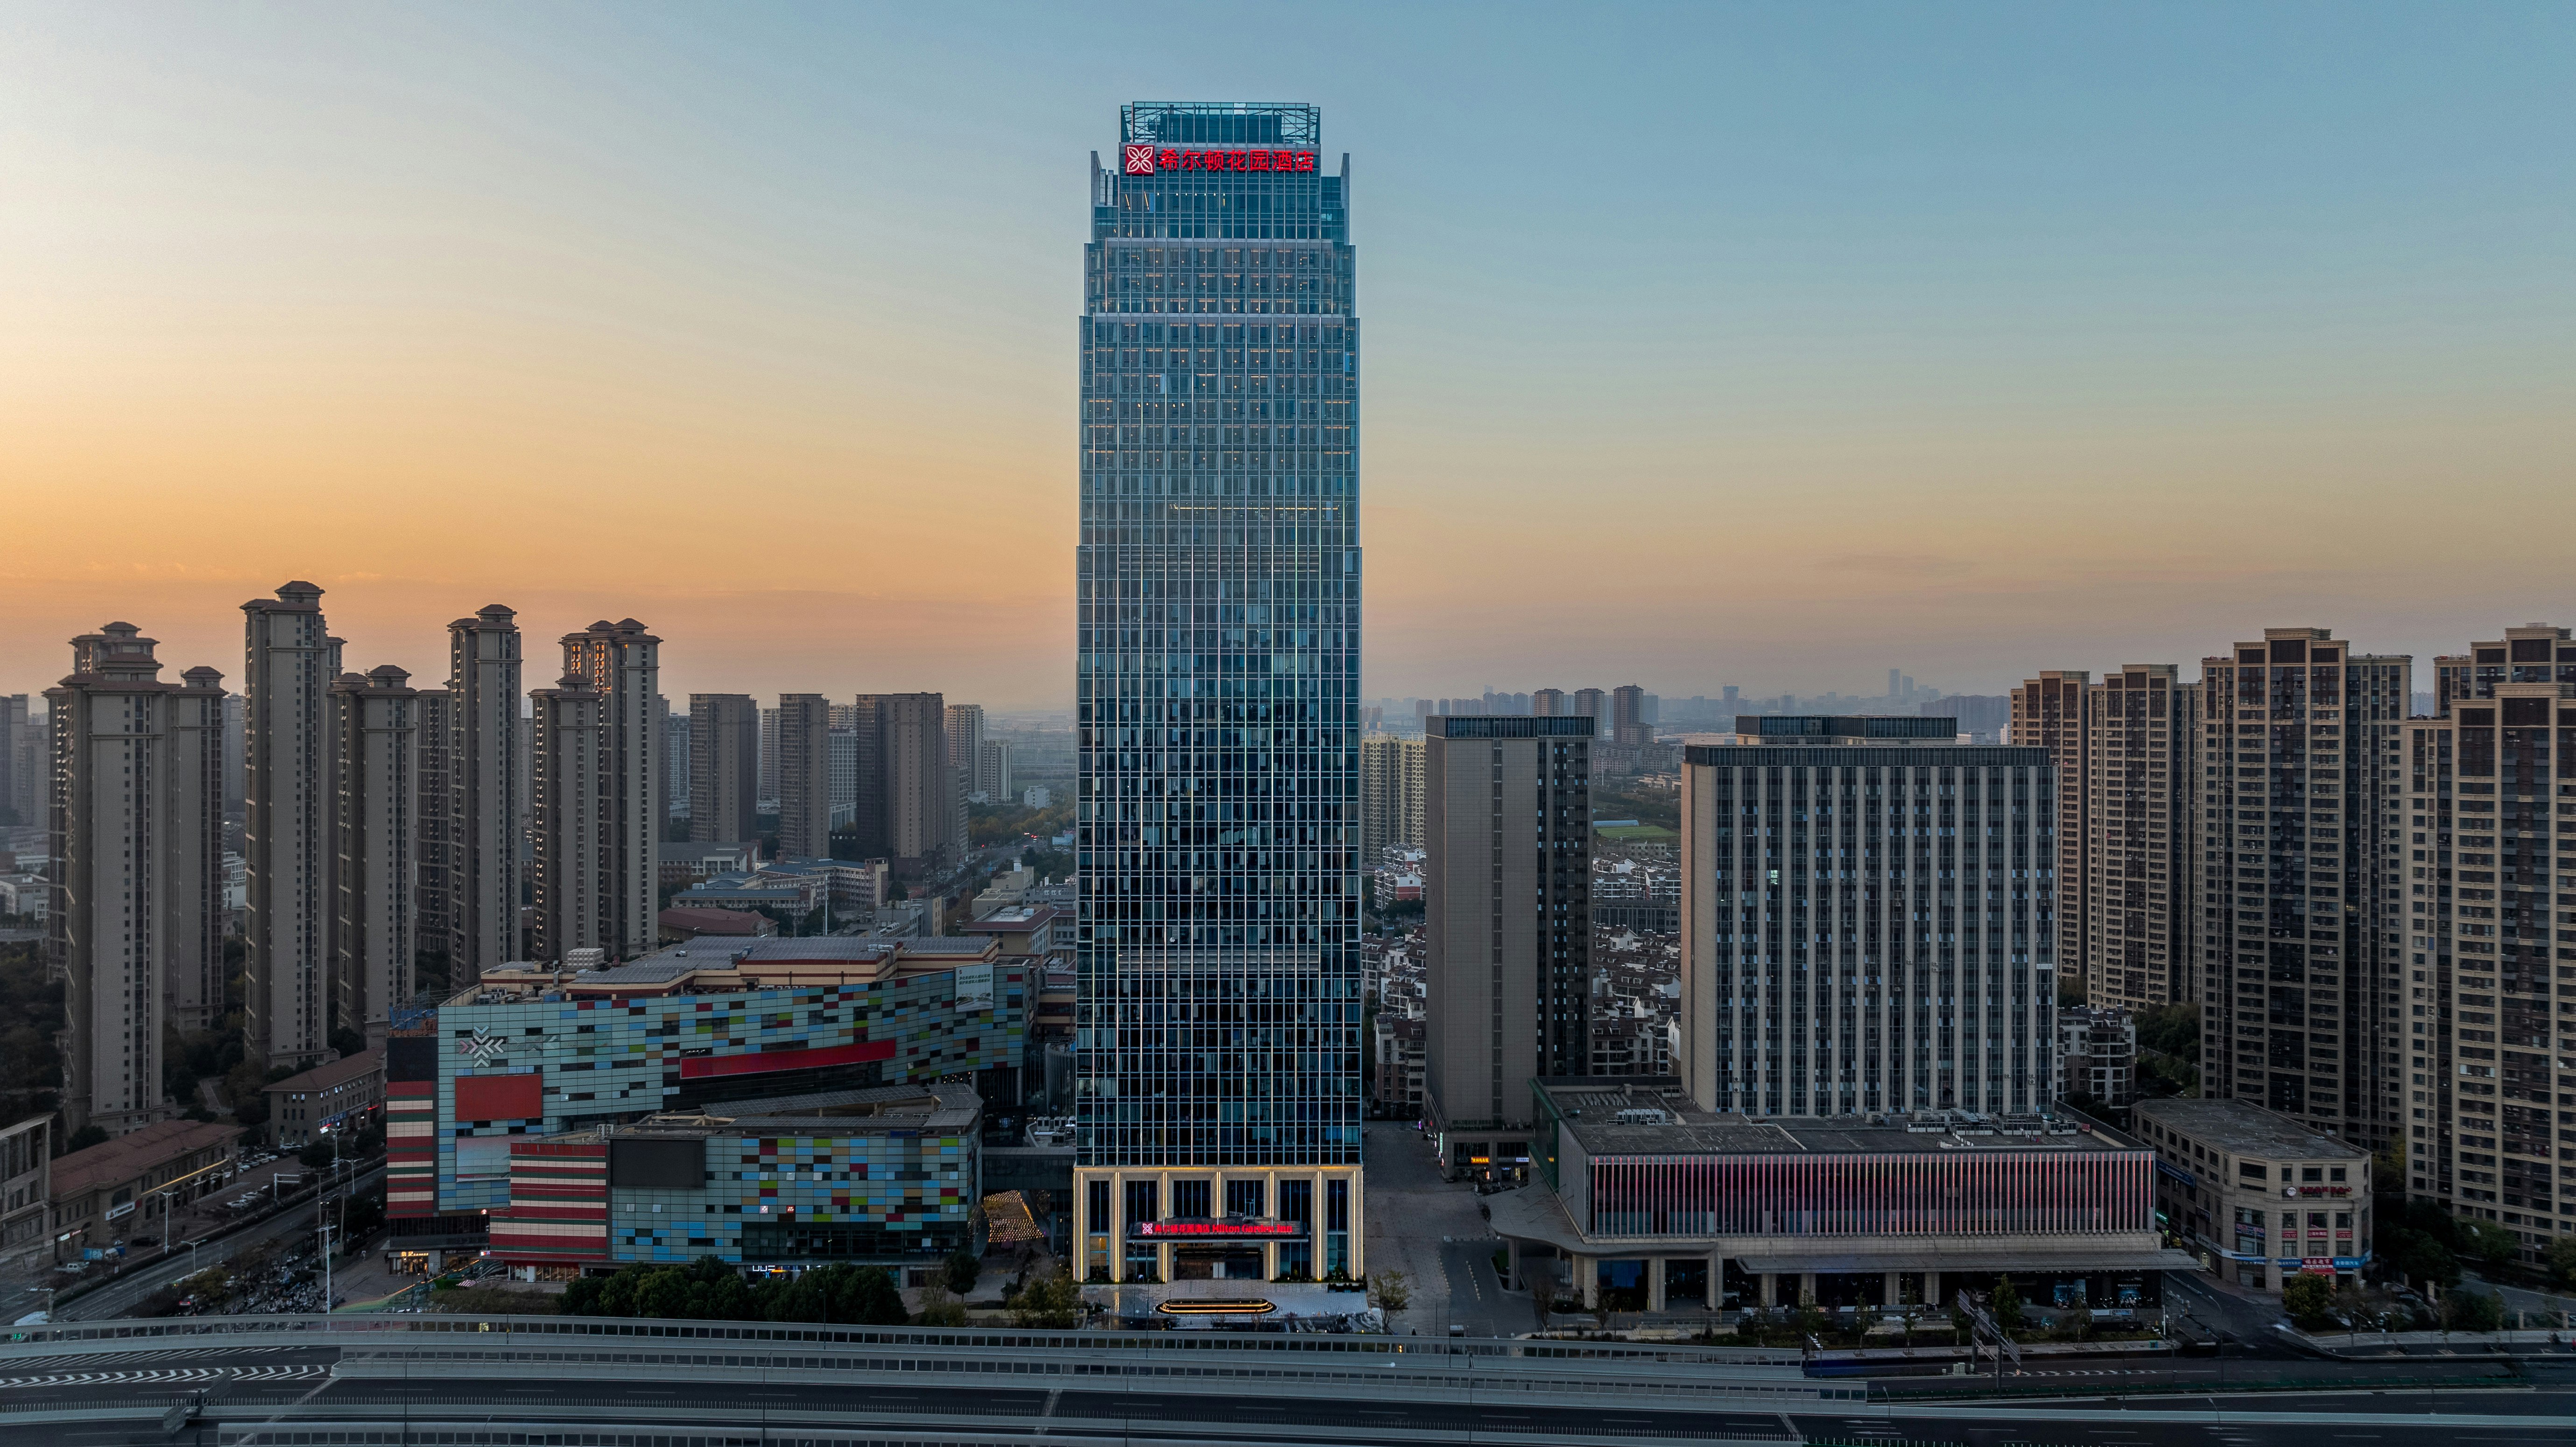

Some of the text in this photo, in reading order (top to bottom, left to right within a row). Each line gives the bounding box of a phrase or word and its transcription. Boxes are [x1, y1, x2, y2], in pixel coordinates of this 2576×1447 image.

[1159, 148, 1314, 172] 希尔顿花园酒店
[1154, 1224, 1292, 1233] 希尔顿花园酒店 Hilton Garden Inn
